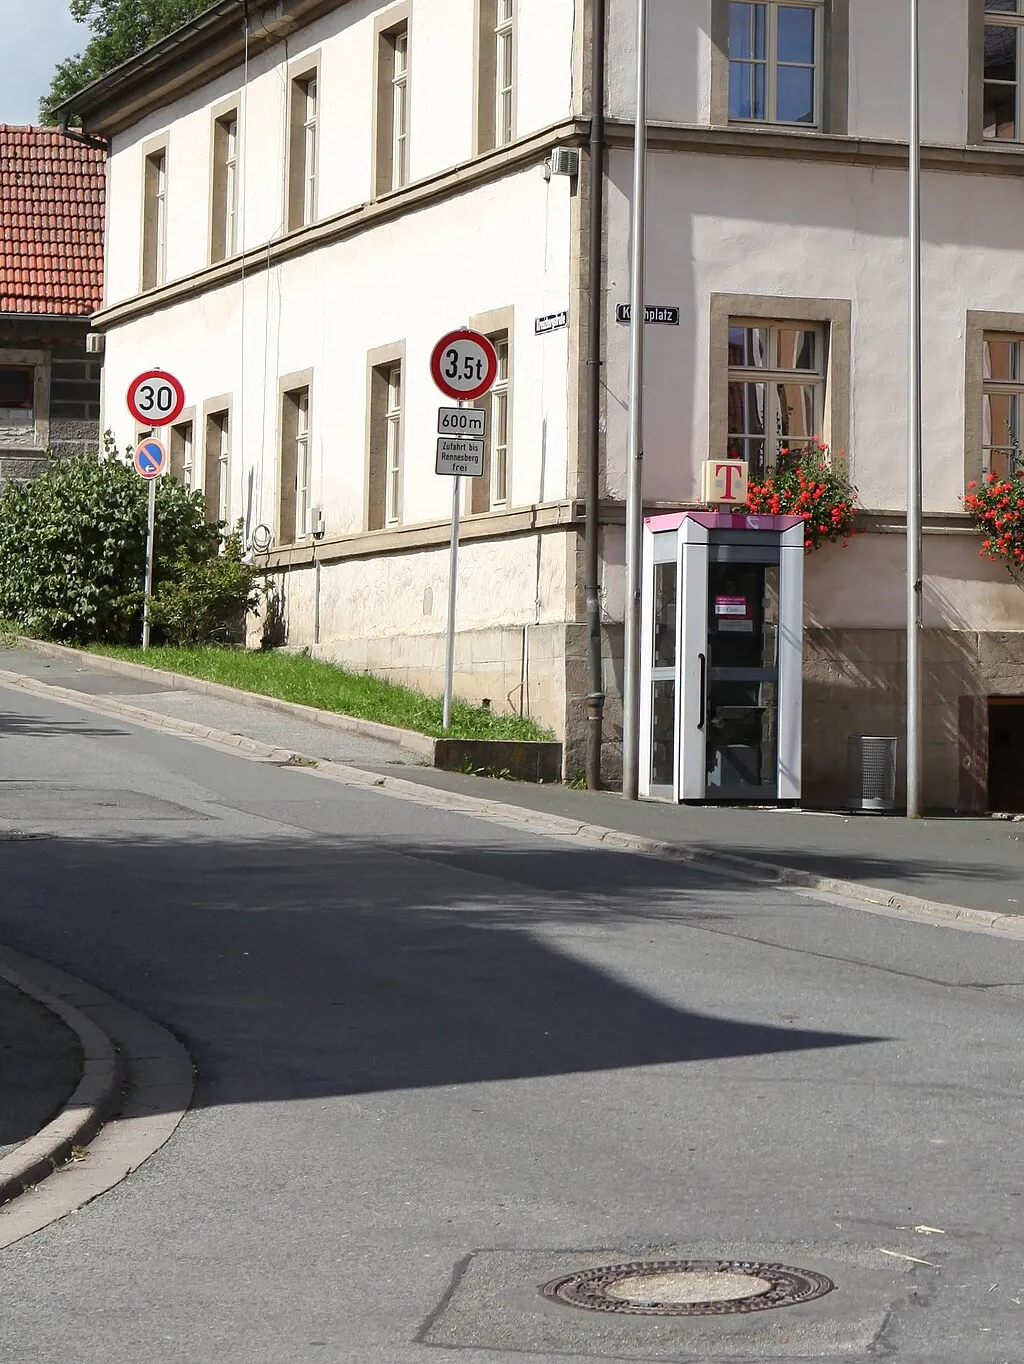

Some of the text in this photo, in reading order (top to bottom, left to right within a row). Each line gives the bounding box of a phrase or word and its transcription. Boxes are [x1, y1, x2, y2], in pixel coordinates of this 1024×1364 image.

[622, 306, 673, 322] Khplatz
[445, 348, 483, 381] 3,5t
[139, 386, 172, 411] 30
[442, 441, 479, 452] Zufahrt bis
[441, 452, 479, 464] Rennesberg
[452, 462, 468, 472] frei
[716, 465, 742, 499] T
